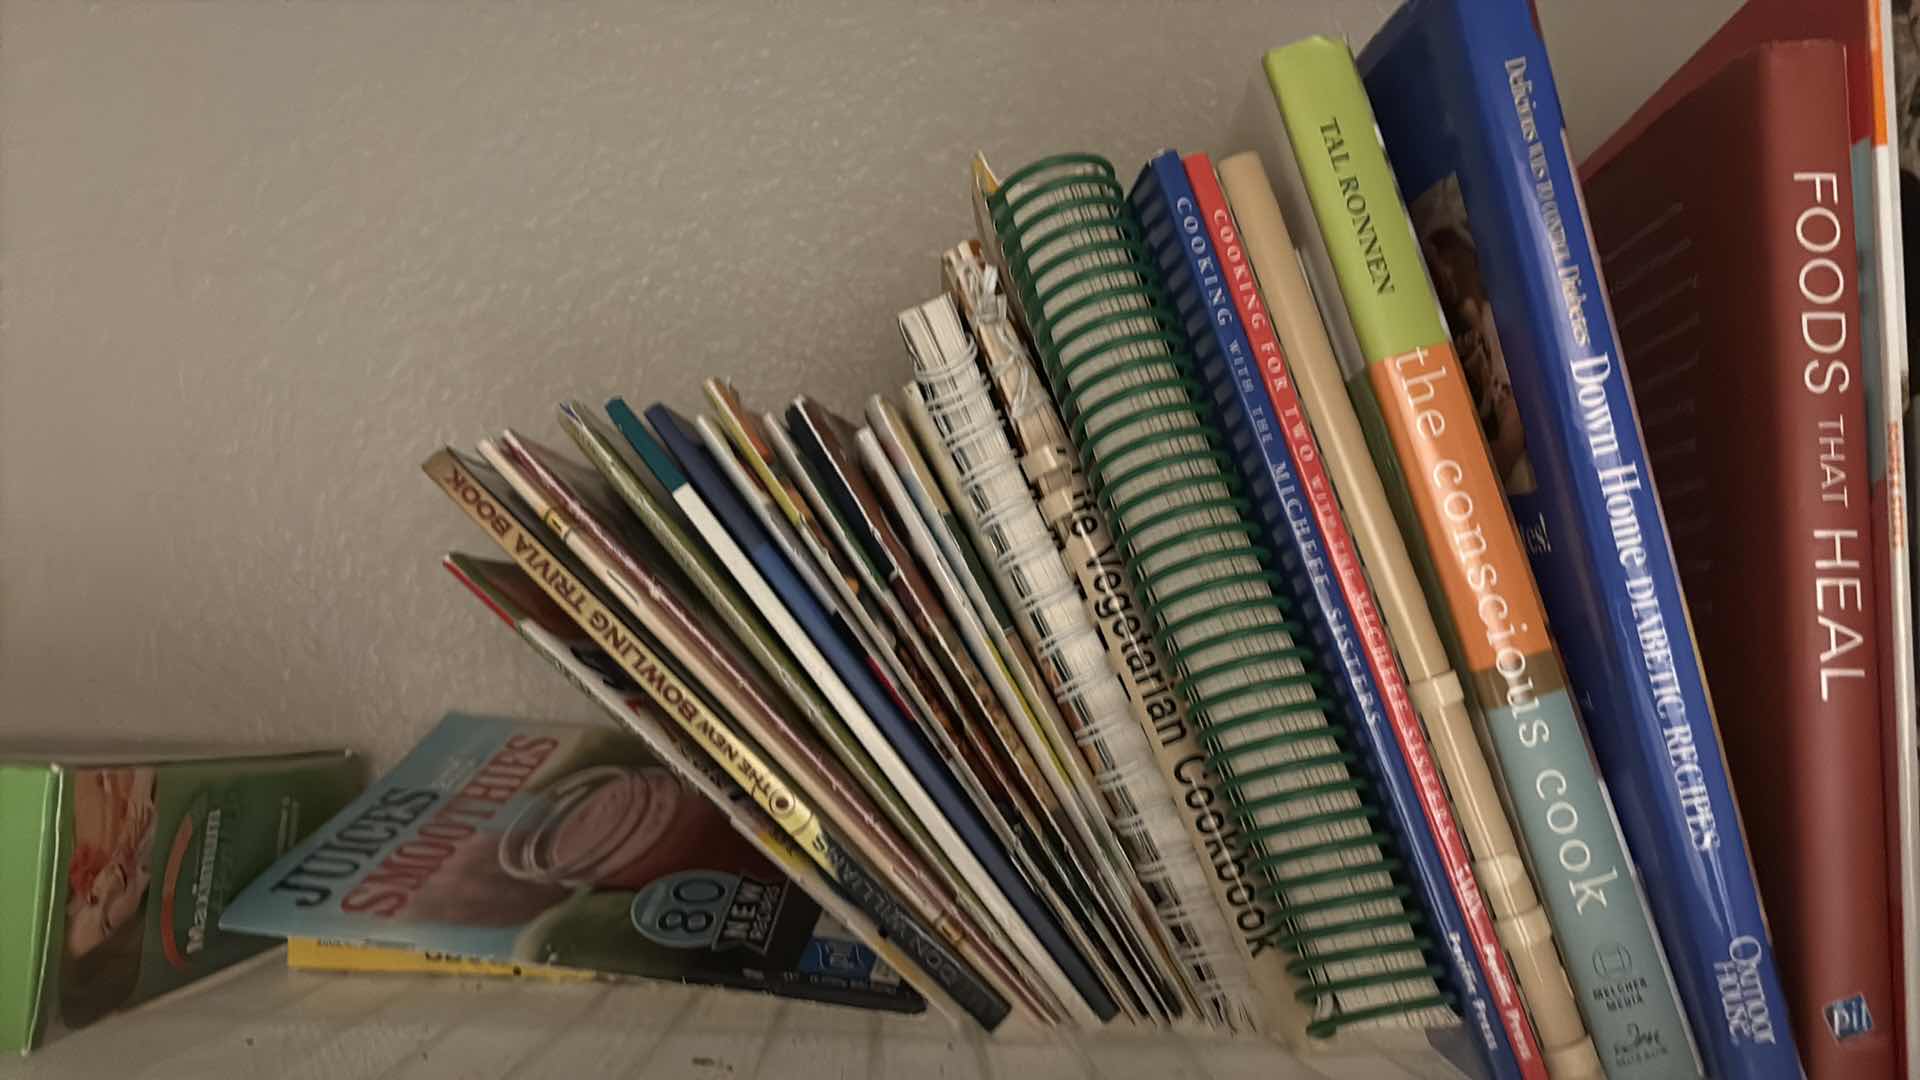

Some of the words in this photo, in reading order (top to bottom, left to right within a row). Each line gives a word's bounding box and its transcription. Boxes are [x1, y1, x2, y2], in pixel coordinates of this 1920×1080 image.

[1319, 116, 1350, 171] TAL
[1338, 175, 1396, 297] RONNEN
[1213, 208, 1268, 330] COOKING
[1260, 342, 1288, 392] FOR
[1285, 406, 1315, 463] TWO
[1794, 171, 1850, 395] FOODS
[446, 468, 514, 537] BOOK
[1176, 197, 1233, 327] COOKING
[1272, 460, 1331, 587] MICHEFF
[1329, 606, 1382, 728] SISTERS
[1818, 413, 1849, 508] THAT
[514, 531, 587, 614] TRIVIA
[1395, 345, 1447, 442] the
[1432, 458, 1551, 748] conscious
[1535, 768, 1619, 917] cook
[1570, 352, 1619, 458] Down
[1597, 459, 1647, 568] Home
[1625, 575, 1686, 721] DIABETIC
[1662, 722, 1721, 852] RECIPES
[1813, 527, 1866, 702] HEAL
[590, 611, 700, 724] BOWLING
[697, 720, 740, 762] NEW
[738, 761, 772, 798] THE
[1086, 543, 1187, 747] Vegetarian
[1173, 754, 1277, 959] Cookbook
[271, 787, 440, 907] JUICES
[341, 735, 558, 918] SMOOTHIES
[656, 877, 727, 934] 80
[722, 881, 765, 940] NEW
